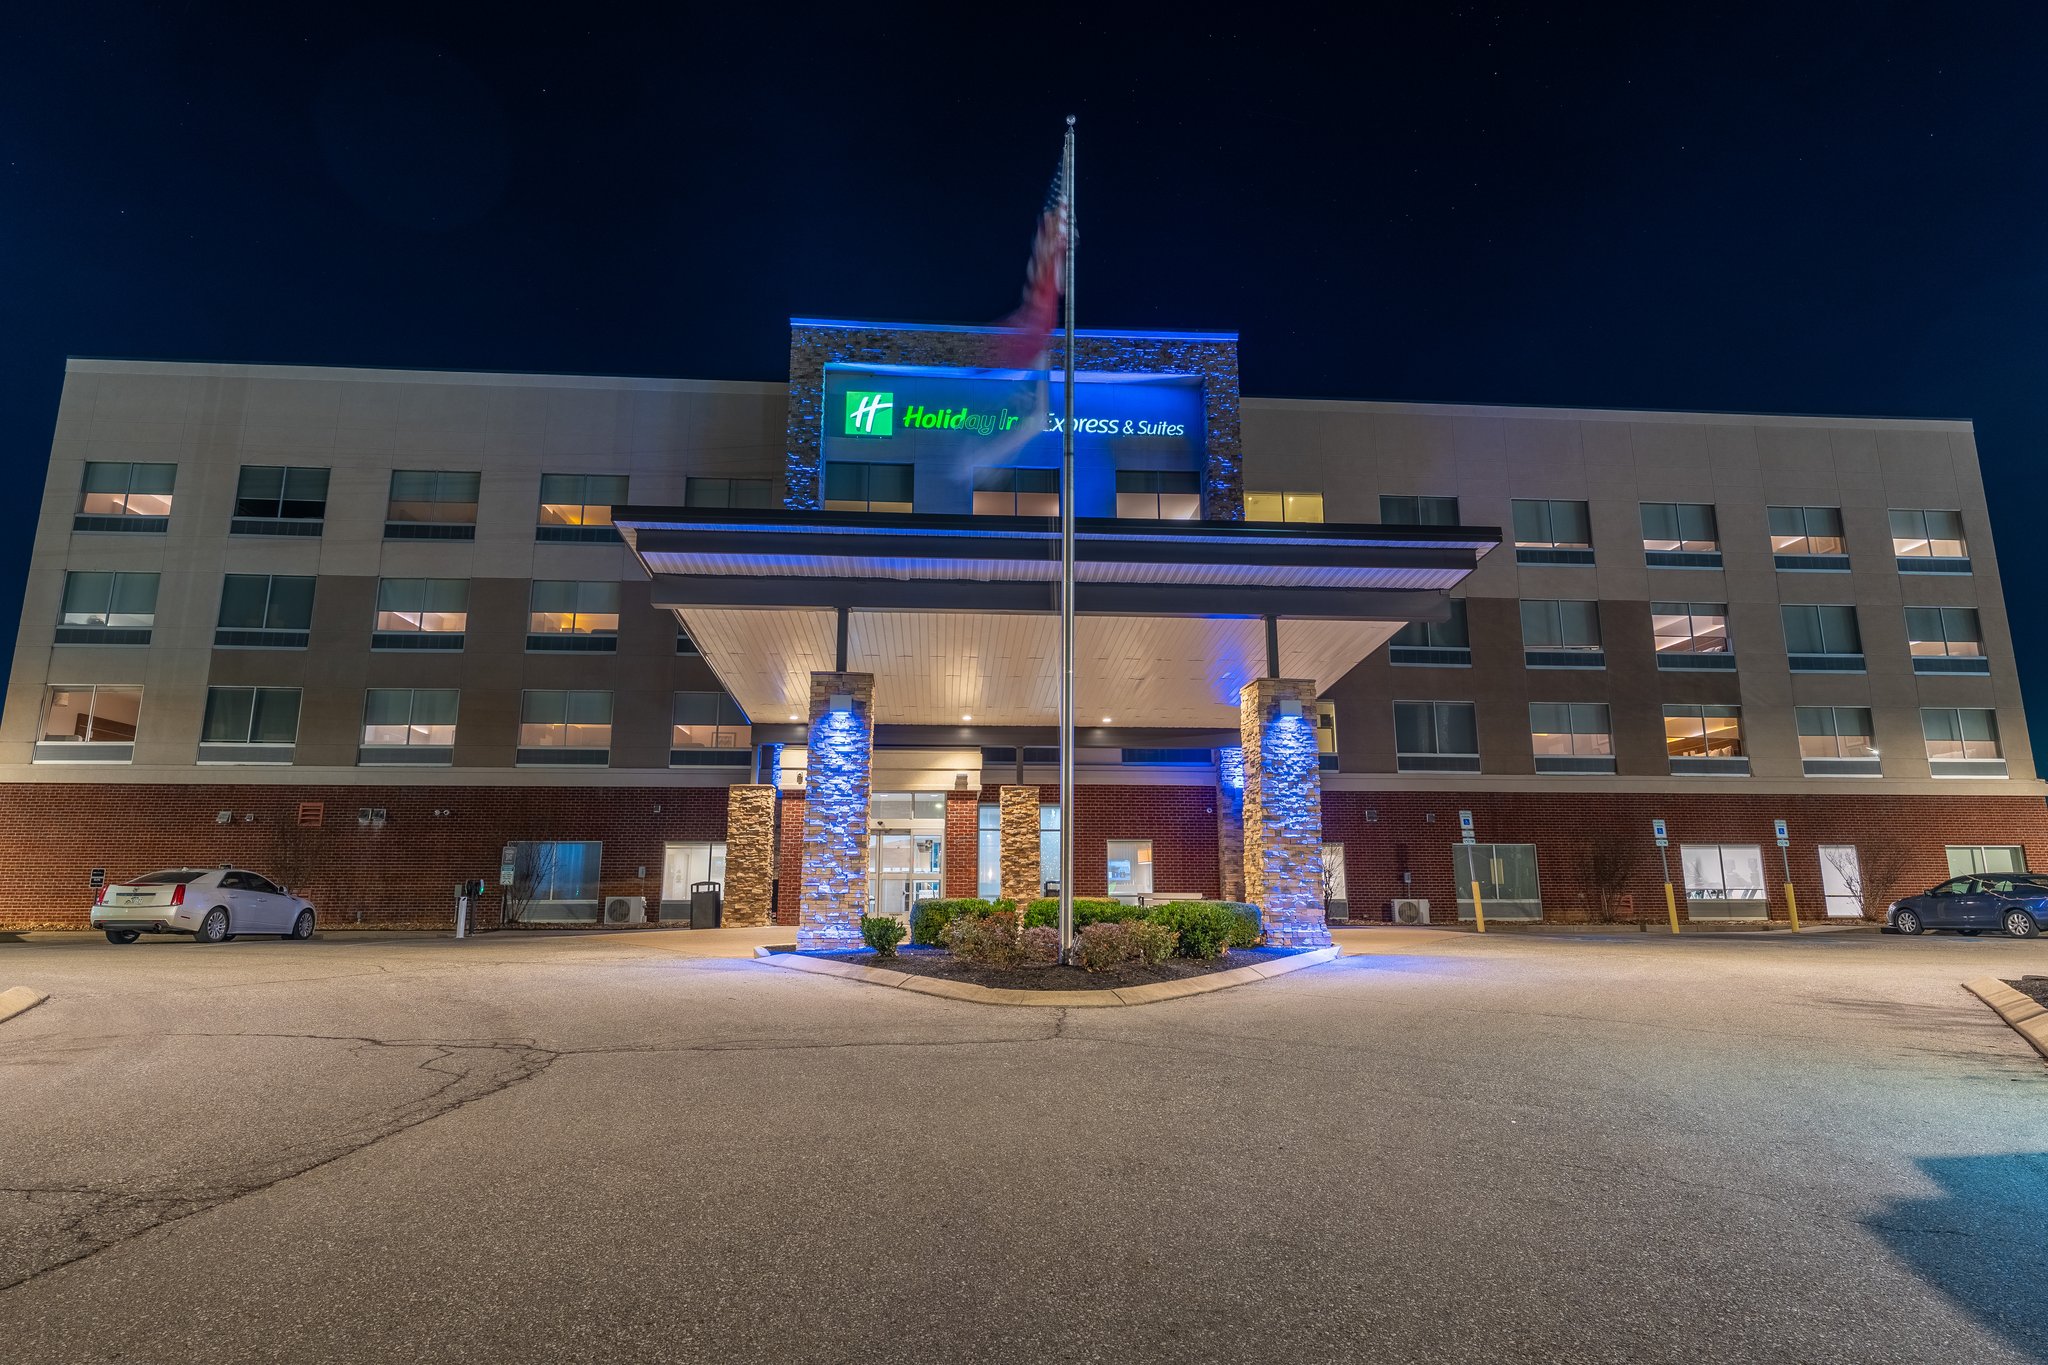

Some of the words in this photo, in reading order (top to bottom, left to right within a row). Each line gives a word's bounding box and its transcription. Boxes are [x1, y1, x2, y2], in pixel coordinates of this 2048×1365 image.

[903, 405, 997, 435] Holiday
[1122, 420, 1134, 434] &
[1137, 420, 1184, 436] Suites
